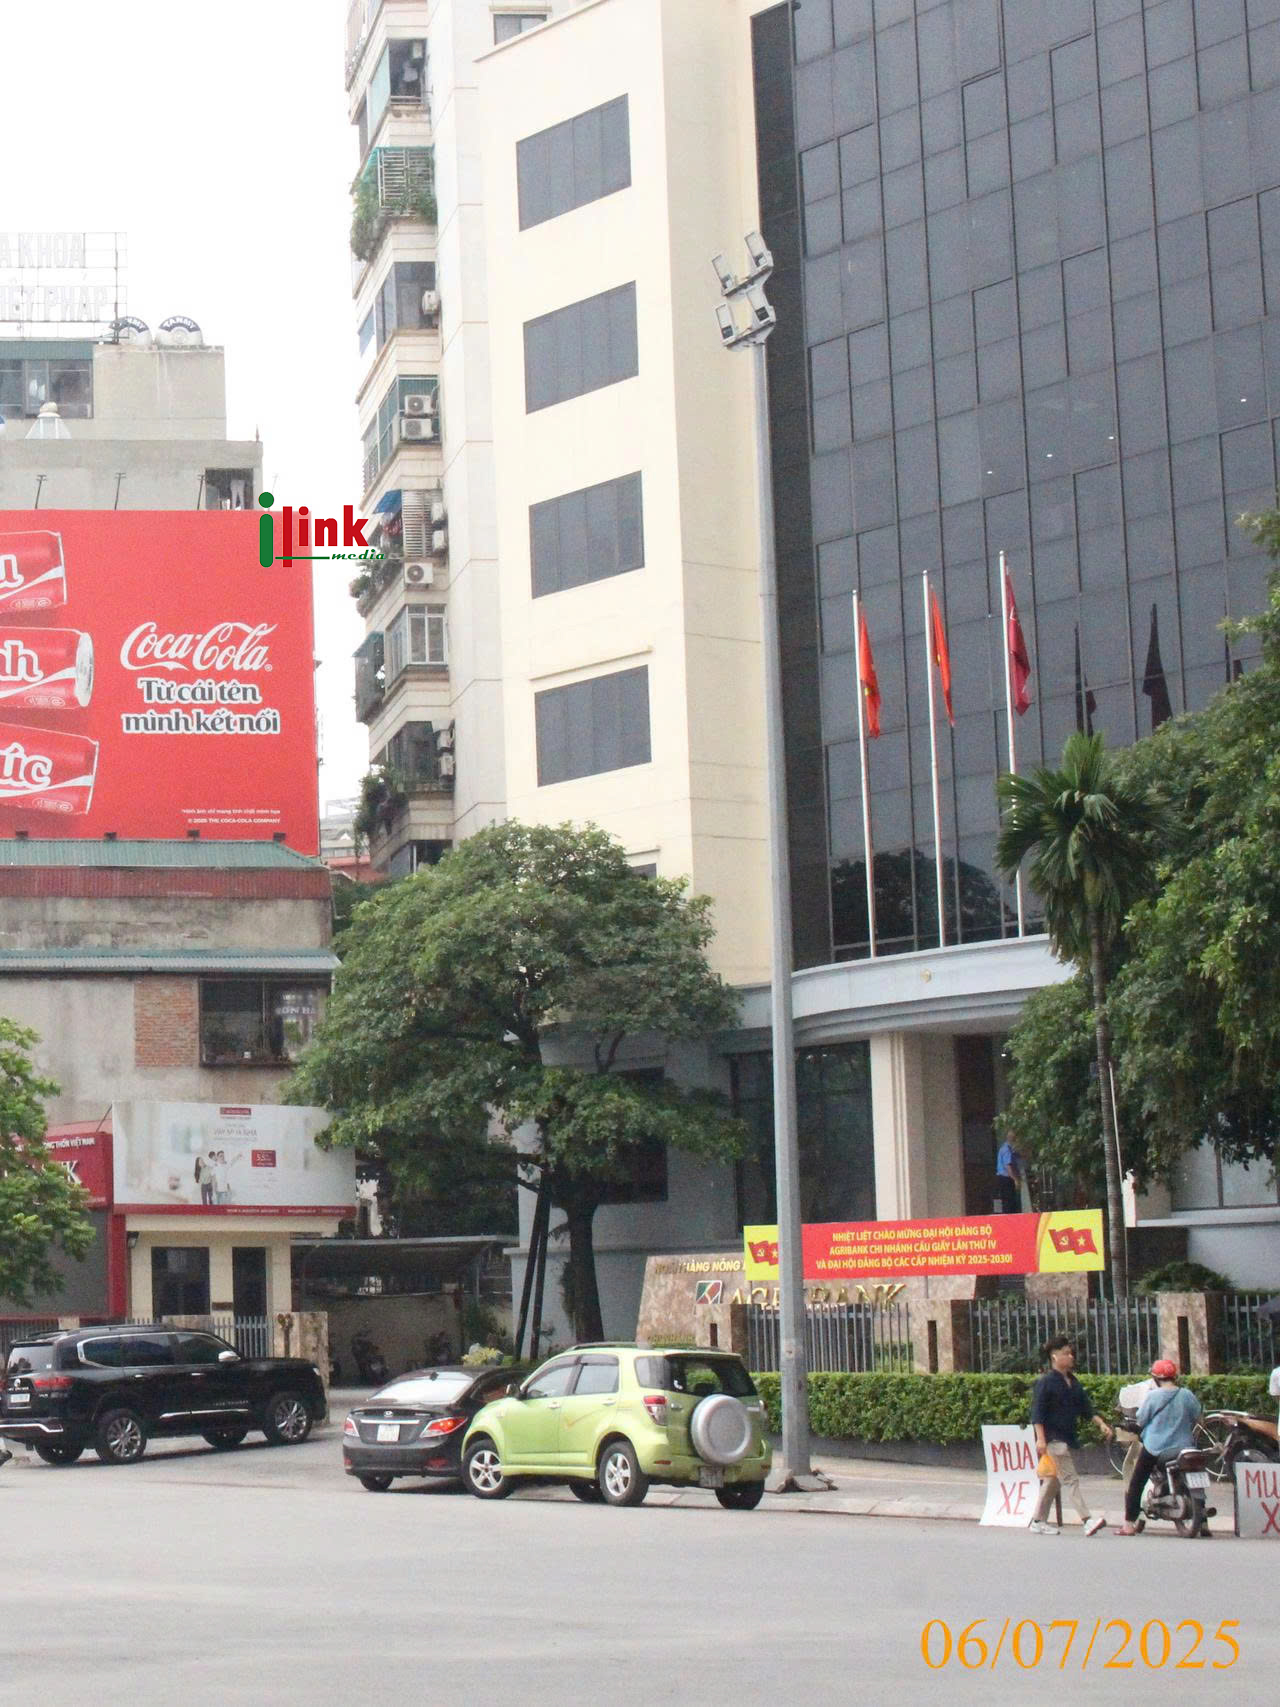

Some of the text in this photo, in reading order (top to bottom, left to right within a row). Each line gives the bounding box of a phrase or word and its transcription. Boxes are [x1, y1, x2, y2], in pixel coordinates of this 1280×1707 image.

[138, 677, 263, 704] Từ cái tên
[122, 707, 281, 734] mình kết nối
[832, 1223, 992, 1243] NHIỆT LIỆT CHÀO MỪNG ĐẠI HỘI ĐẢNG BỘ
[829, 1238, 997, 1256] AGRIBANK CHI NHÁNH CẦU GIẤY LẦN THỨ IV
[712, 1259, 741, 1272] NÔNG
[816, 1258, 827, 1269] VÀ
[827, 1258, 841, 1271] ĐẠI
[842, 1257, 857, 1270] HỘI
[857, 1256, 880, 1269] ĐẢNG
[881, 1255, 892, 1270] BỘ
[894, 1254, 910, 1267] CÁC
[911, 1253, 926, 1267] CẤP
[927, 1254, 954, 1268] NHIỆM
[732, 1284, 907, 1311] AGBANK
[991, 1440, 1035, 1473] MUA
[1245, 1469, 1280, 1499] MU
[997, 1481, 1030, 1515] XE
[1261, 1501, 1280, 1535] X
